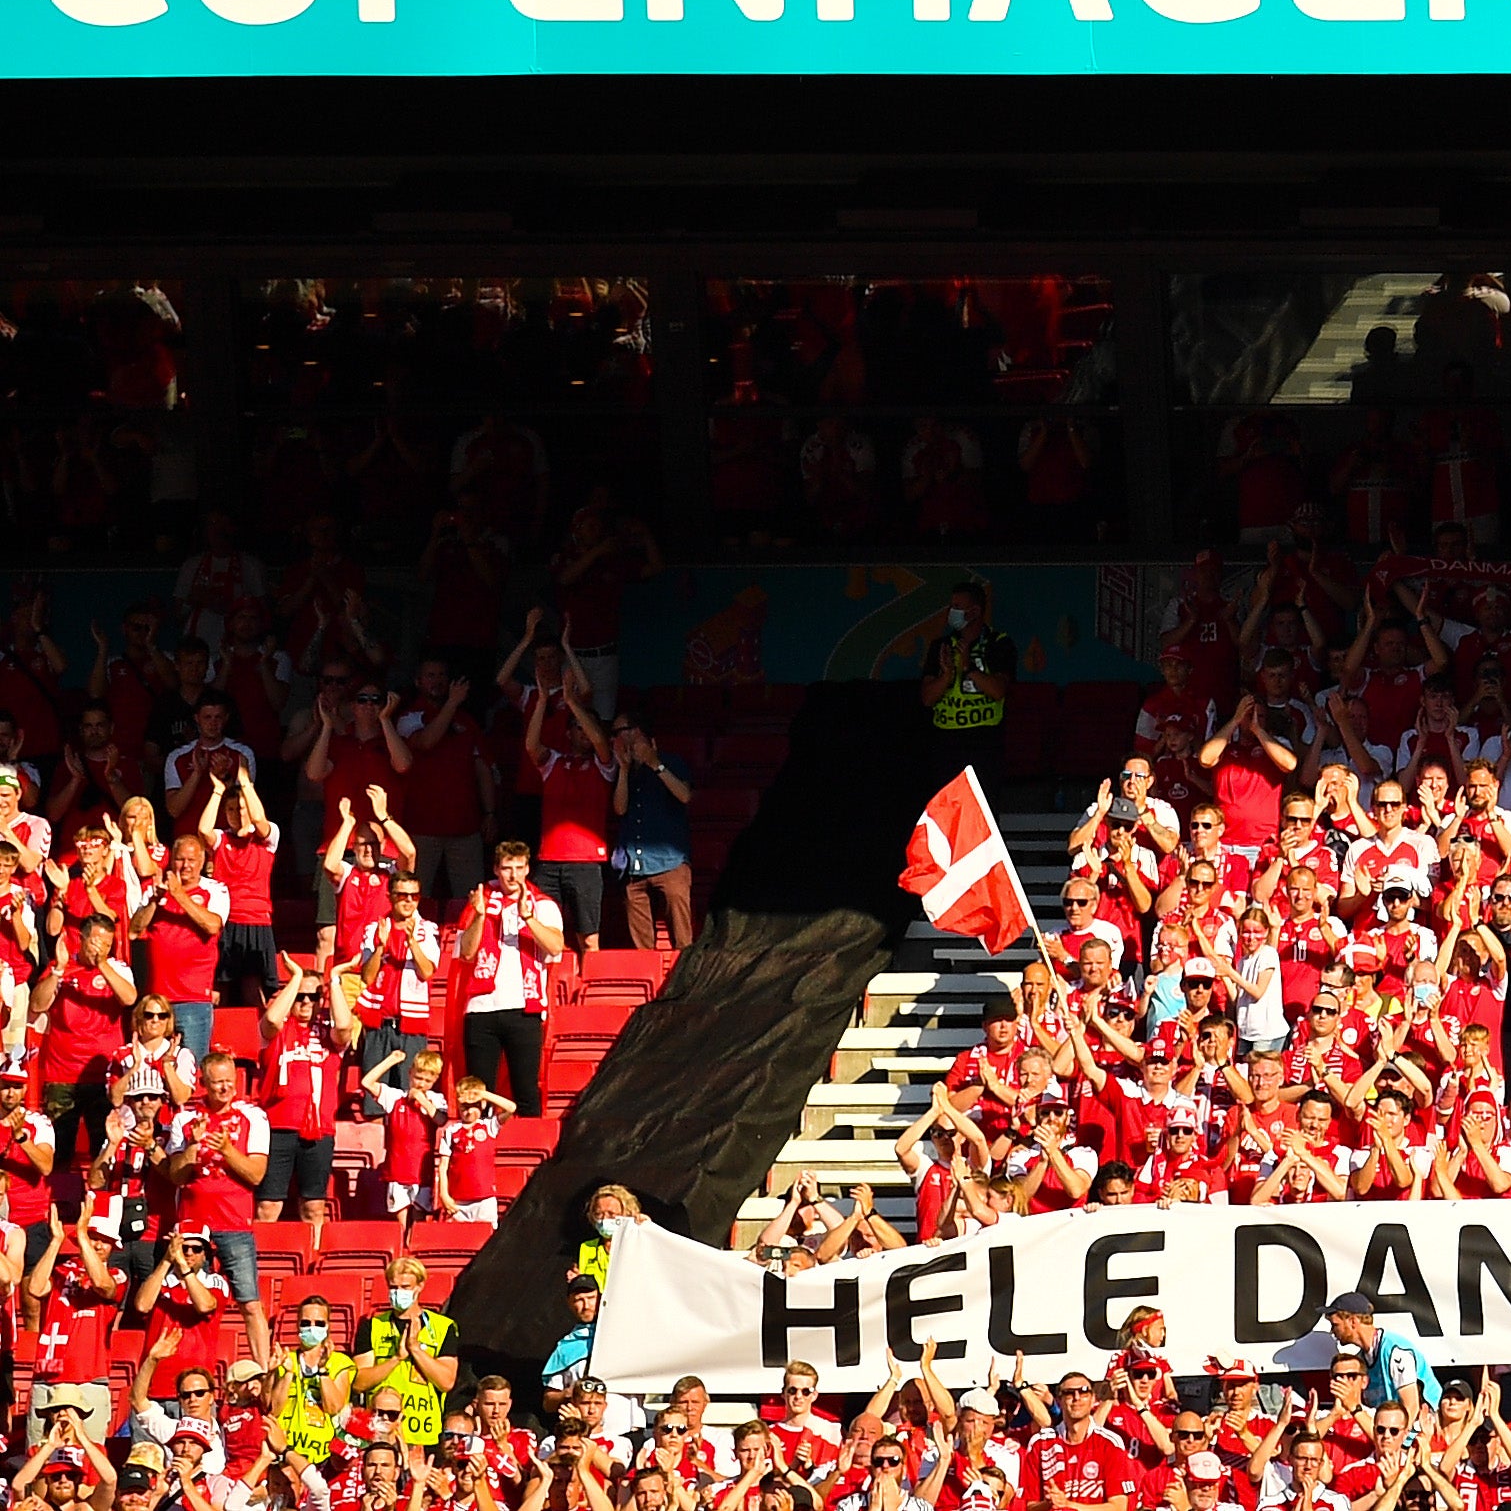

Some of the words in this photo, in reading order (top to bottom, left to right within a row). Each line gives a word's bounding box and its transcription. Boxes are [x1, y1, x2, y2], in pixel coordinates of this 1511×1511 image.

[1200, 622, 1218, 643] 23
[1293, 941, 1307, 962] 10
[761, 1230, 1166, 1368] HELE
